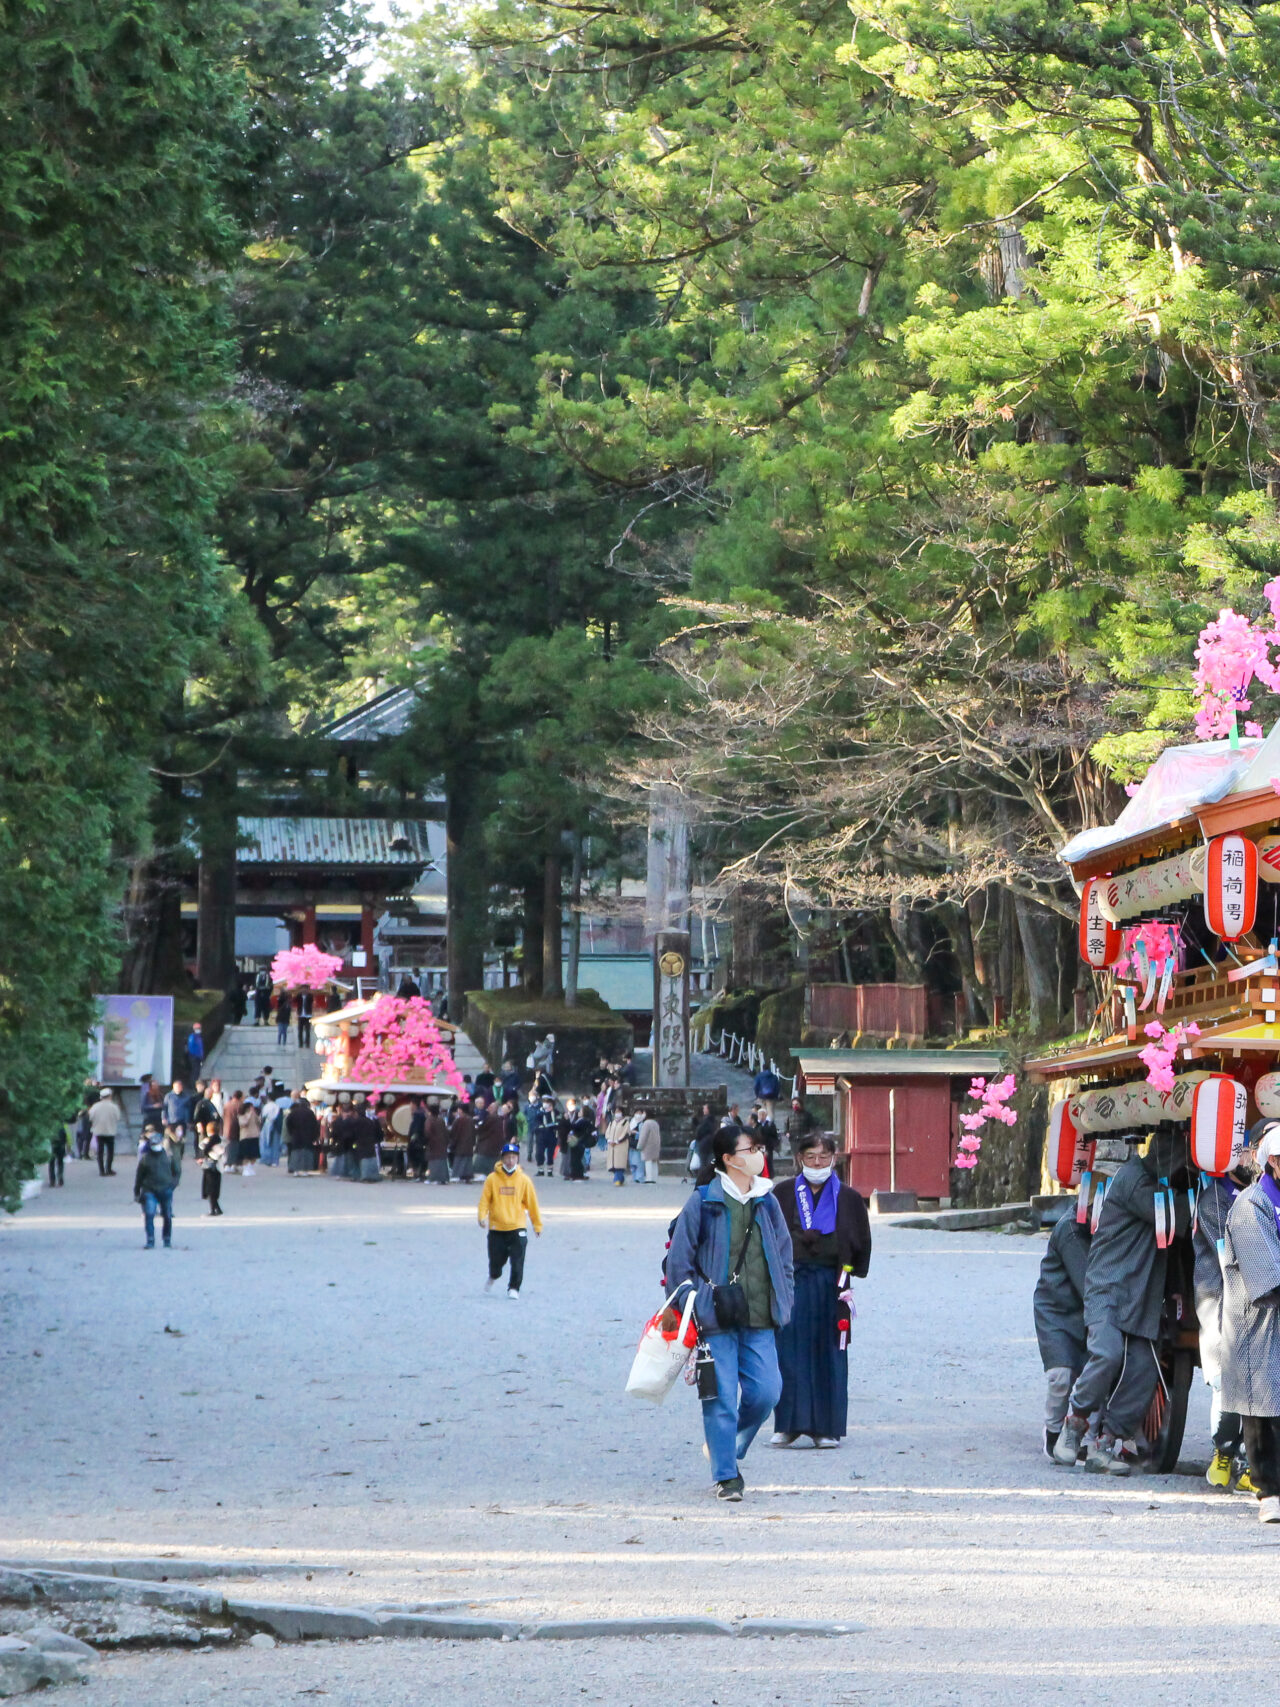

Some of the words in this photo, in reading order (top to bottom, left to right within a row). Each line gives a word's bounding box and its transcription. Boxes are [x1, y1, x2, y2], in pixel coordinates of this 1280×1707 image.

[662, 992, 685, 1077] 東照宮
[1232, 1093, 1247, 1158] 弥生祭
